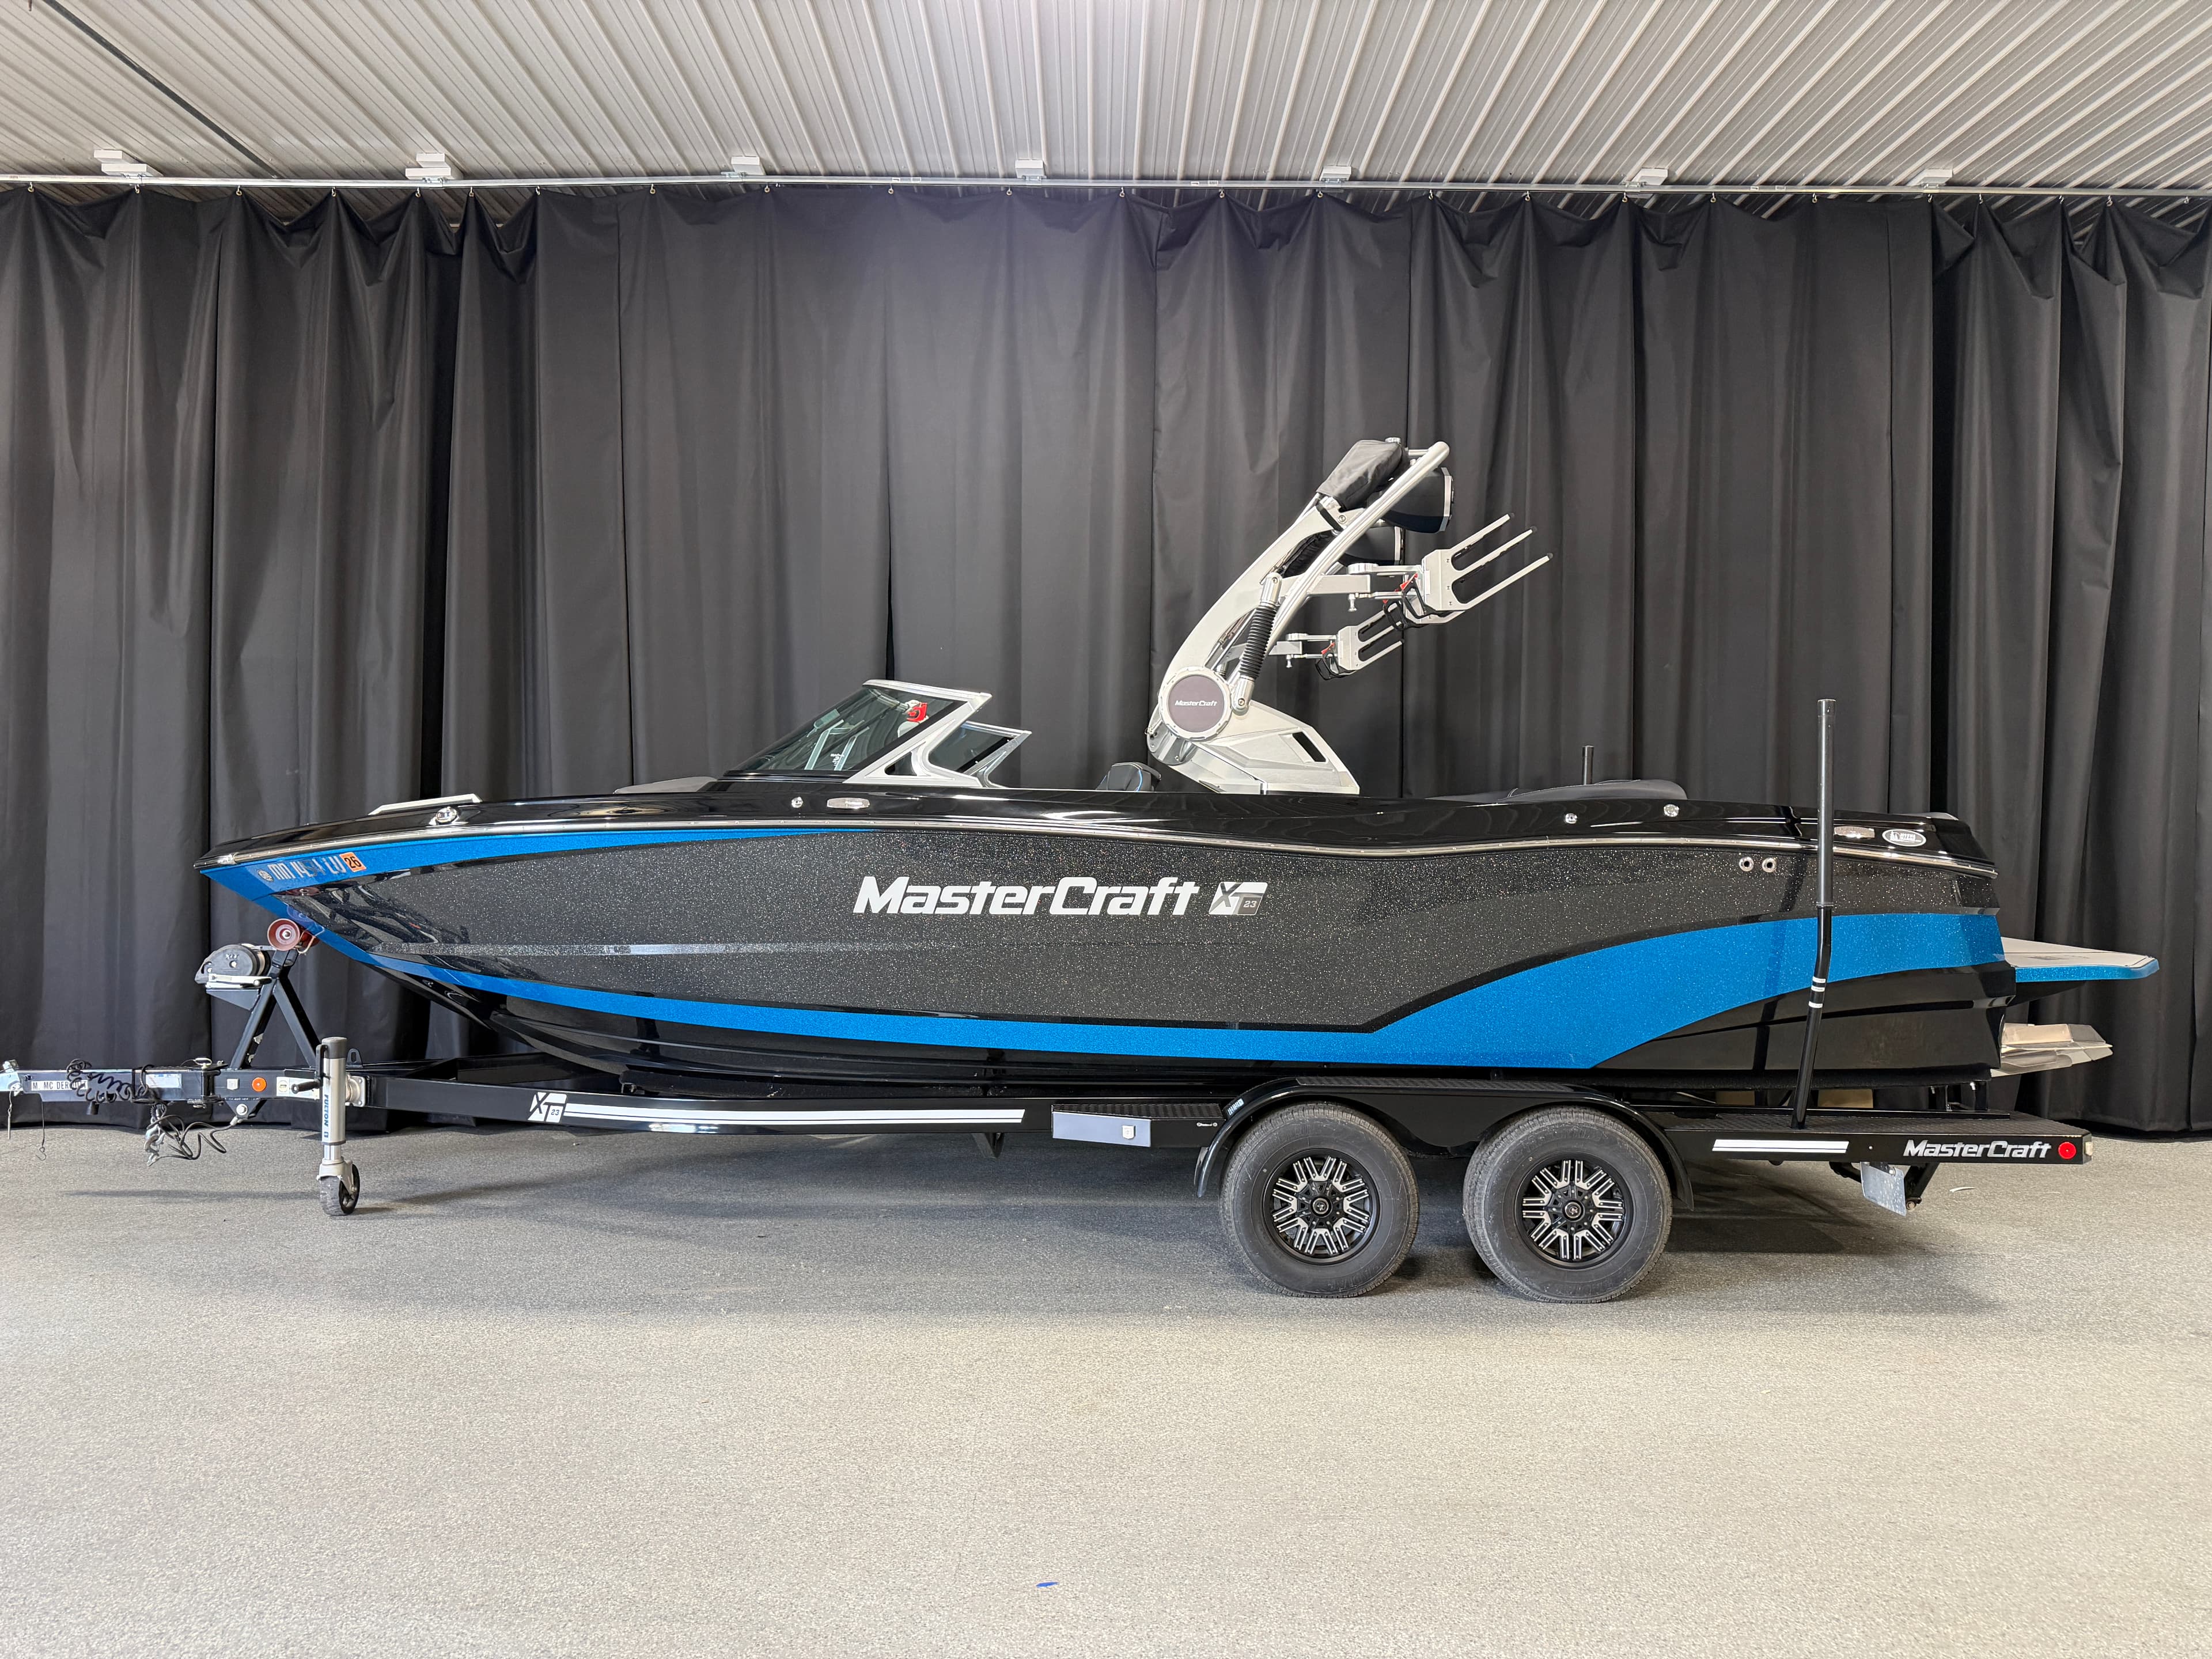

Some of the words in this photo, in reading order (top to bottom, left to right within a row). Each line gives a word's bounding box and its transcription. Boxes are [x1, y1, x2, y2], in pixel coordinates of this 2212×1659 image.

[344, 857, 362, 869] 26
[853, 876, 1200, 916] MasterCraft
[1903, 1139, 2052, 1158] MasterCraft
